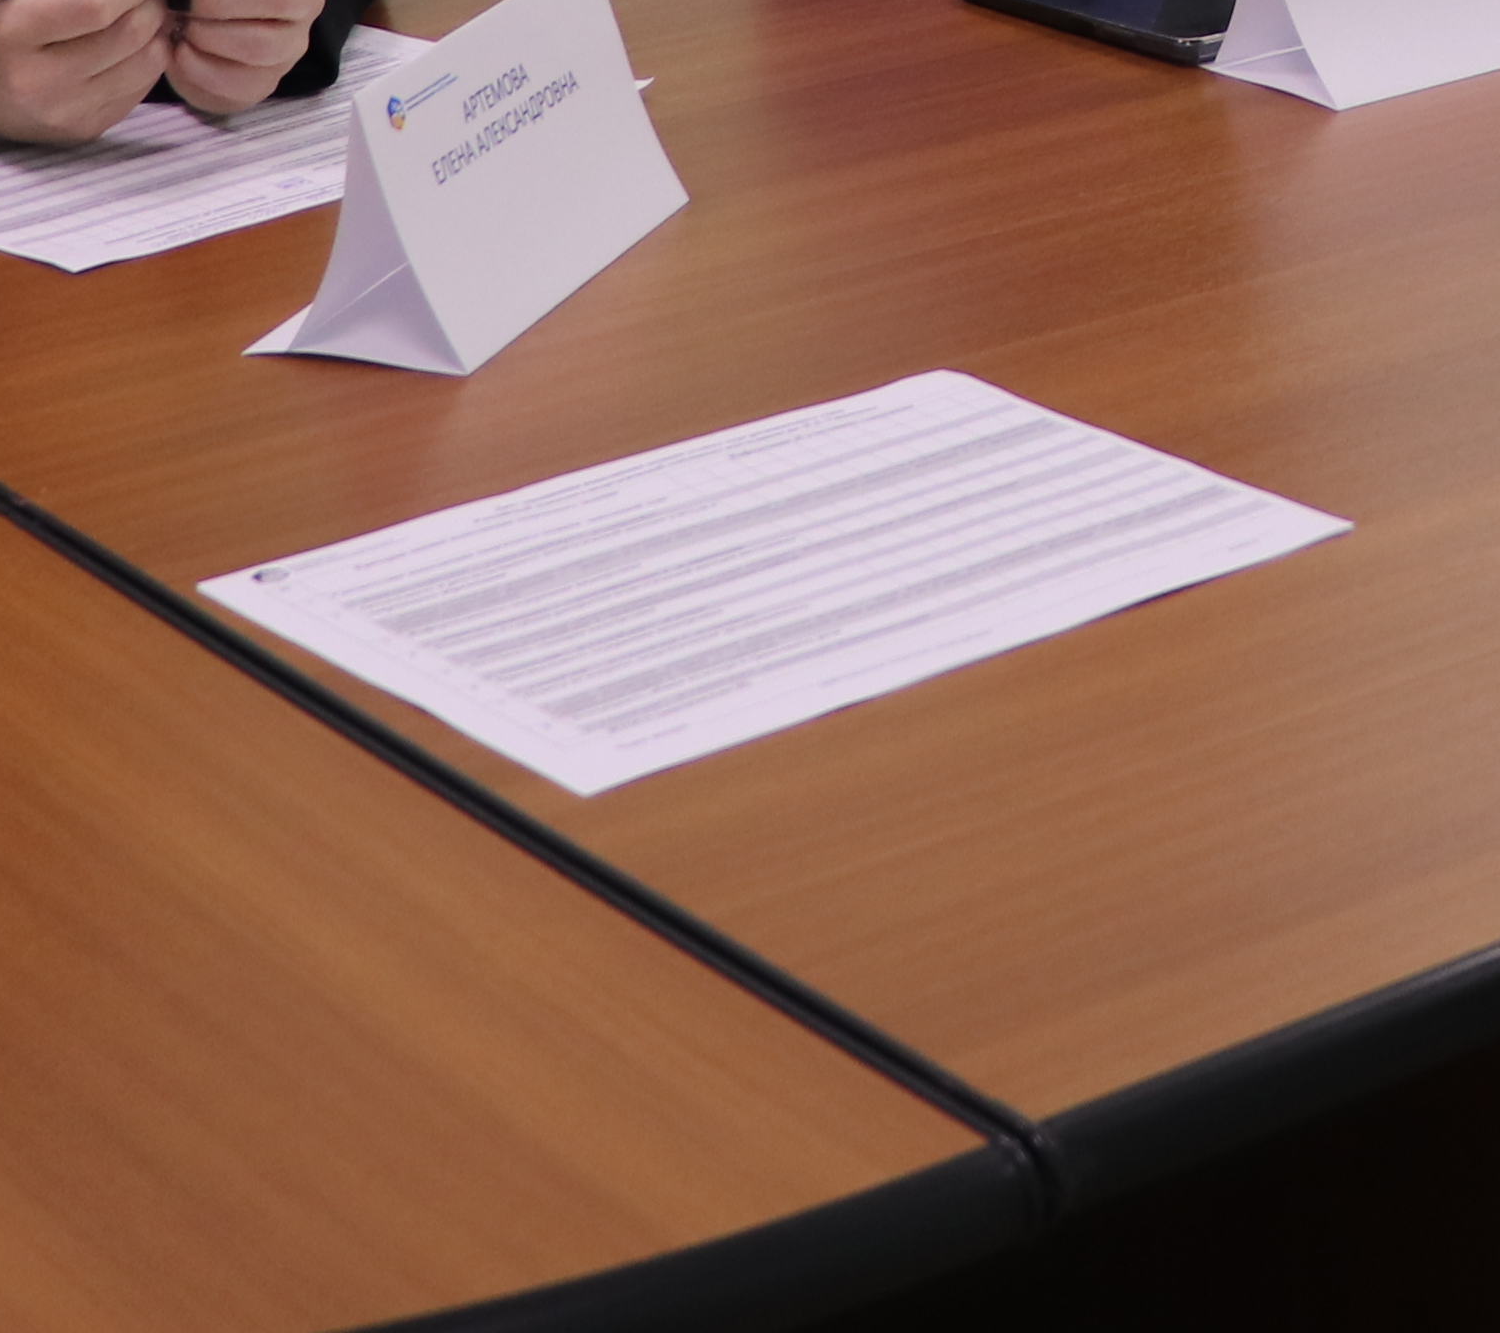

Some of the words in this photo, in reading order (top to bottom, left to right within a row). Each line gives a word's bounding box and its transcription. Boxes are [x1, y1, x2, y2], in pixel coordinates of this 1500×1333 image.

[432, 140, 477, 184] ЕЛЕНА
[477, 71, 580, 155] АЛЕКСАНДРОВНА
[463, 63, 530, 123] АРТЕМОВА
